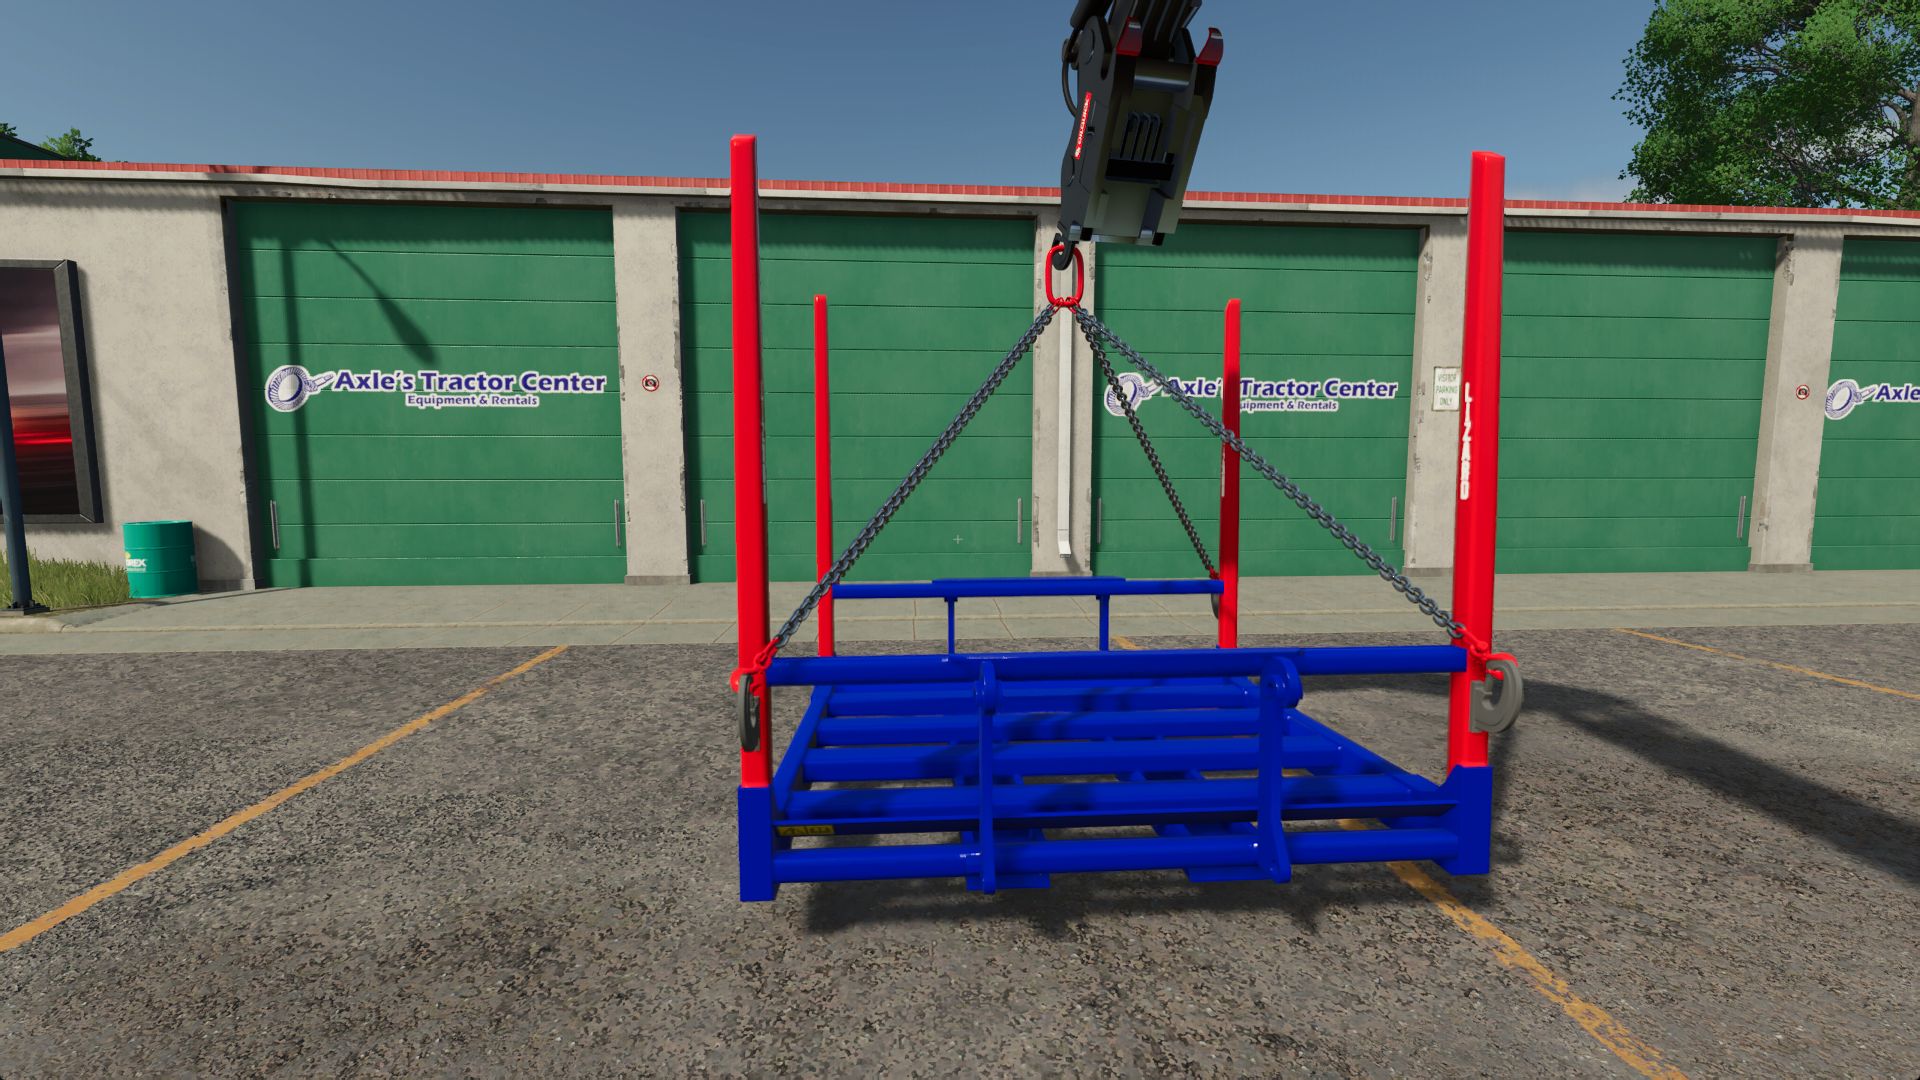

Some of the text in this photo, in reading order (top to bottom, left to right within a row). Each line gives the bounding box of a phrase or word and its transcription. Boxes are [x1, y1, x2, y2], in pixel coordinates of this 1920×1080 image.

[335, 372, 606, 391] Axle's Tractor Center
[1438, 373, 1457, 382] VISITOR
[1240, 380, 1319, 396] Tractor
[1325, 380, 1397, 396] Center
[1436, 385, 1458, 393] PARKING
[408, 395, 537, 407] Equipment & Rentals
[1240, 400, 1337, 411] uipment & Rentals
[1439, 397, 1453, 405] ONLY
[1460, 382, 1472, 500] LIZARD
